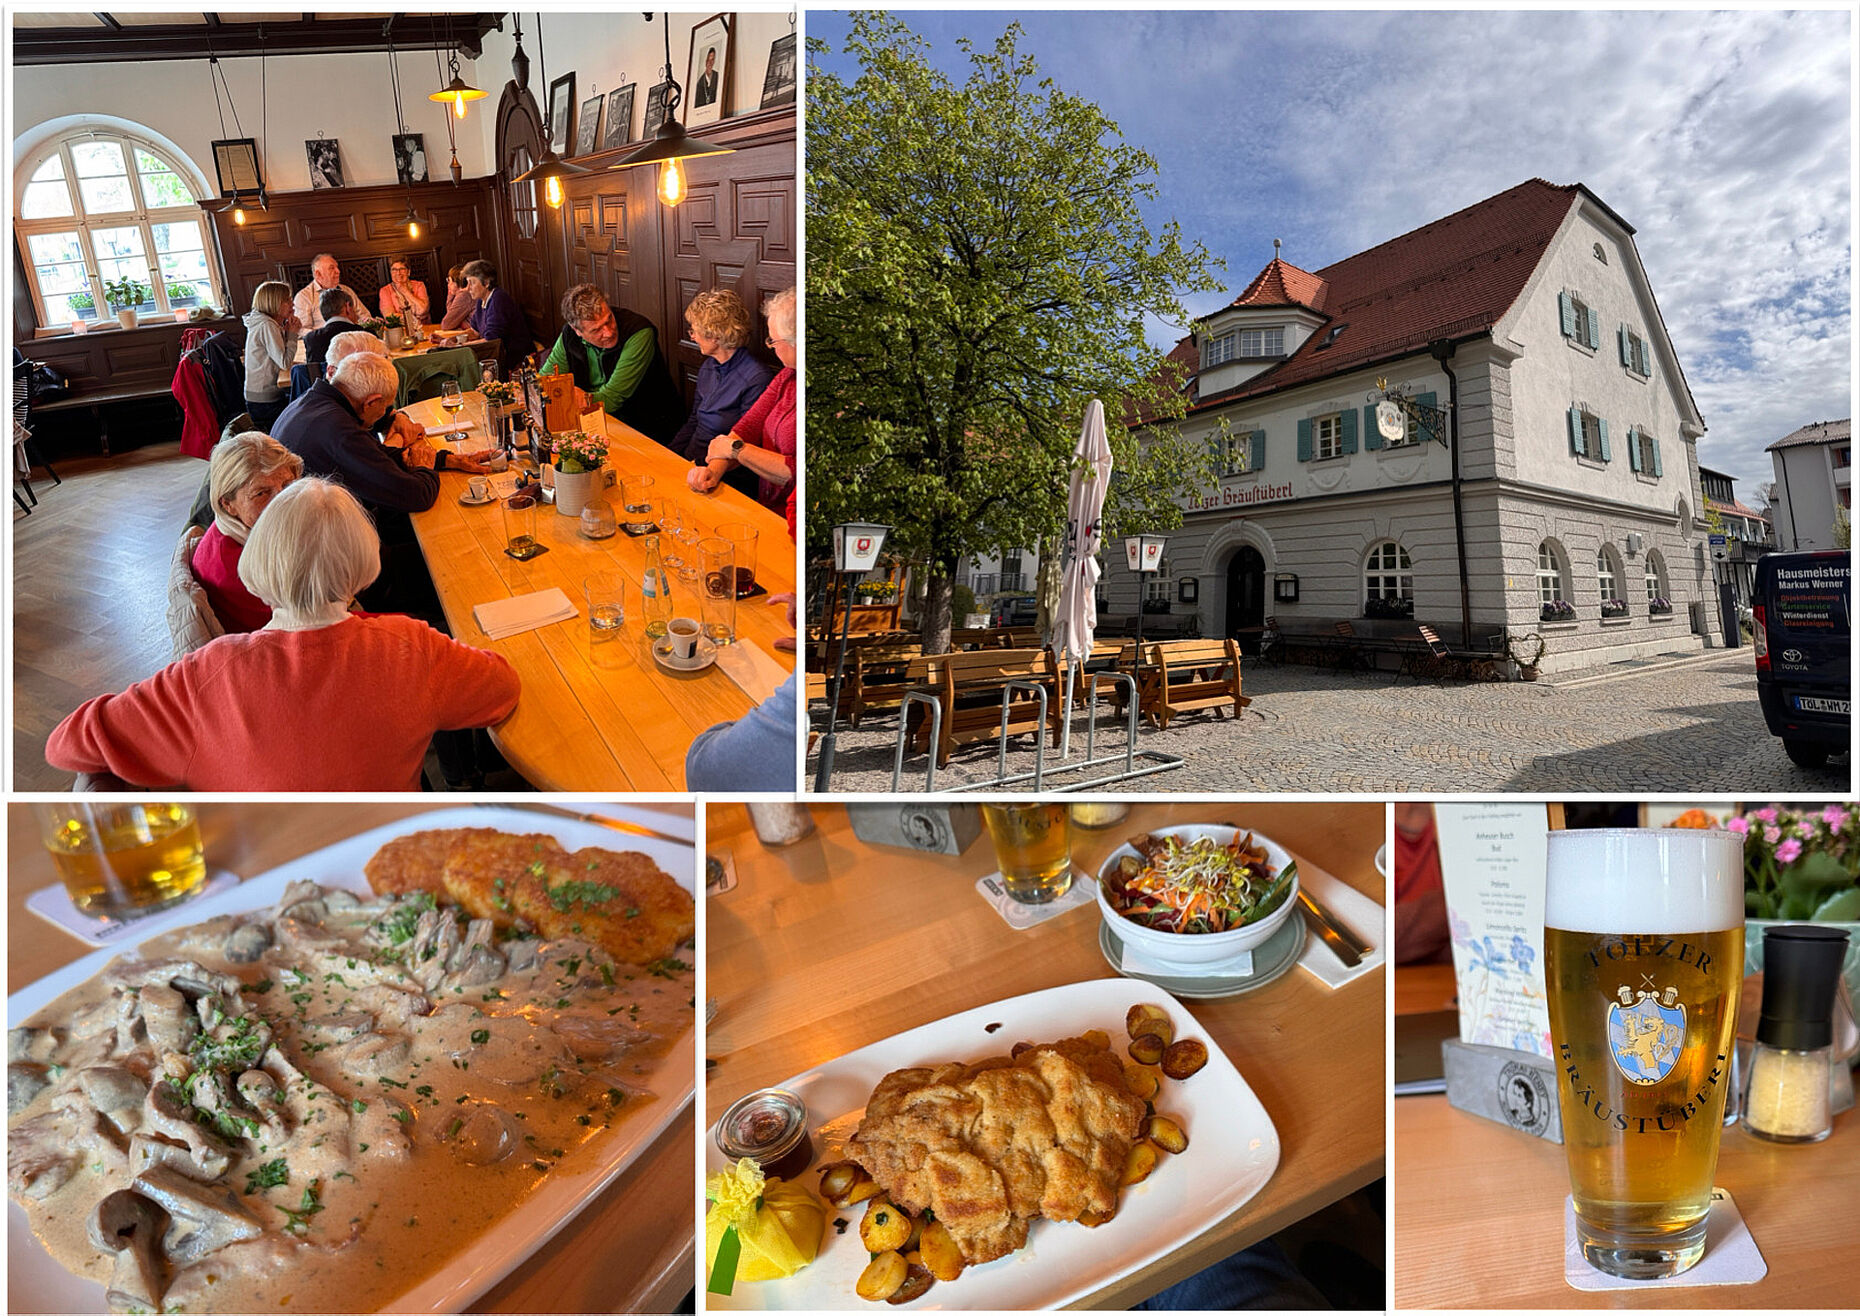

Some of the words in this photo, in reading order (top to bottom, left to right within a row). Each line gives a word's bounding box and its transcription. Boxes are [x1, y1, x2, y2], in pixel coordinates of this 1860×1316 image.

[1779, 581, 1810, 590] Markus
[1811, 580, 1844, 589] Werner
[1782, 612, 1829, 620] Winterdienst
[1781, 663, 1808, 672] TOYOTA
[1560, 1043, 1728, 1133] BRÄUSTÜBERL
